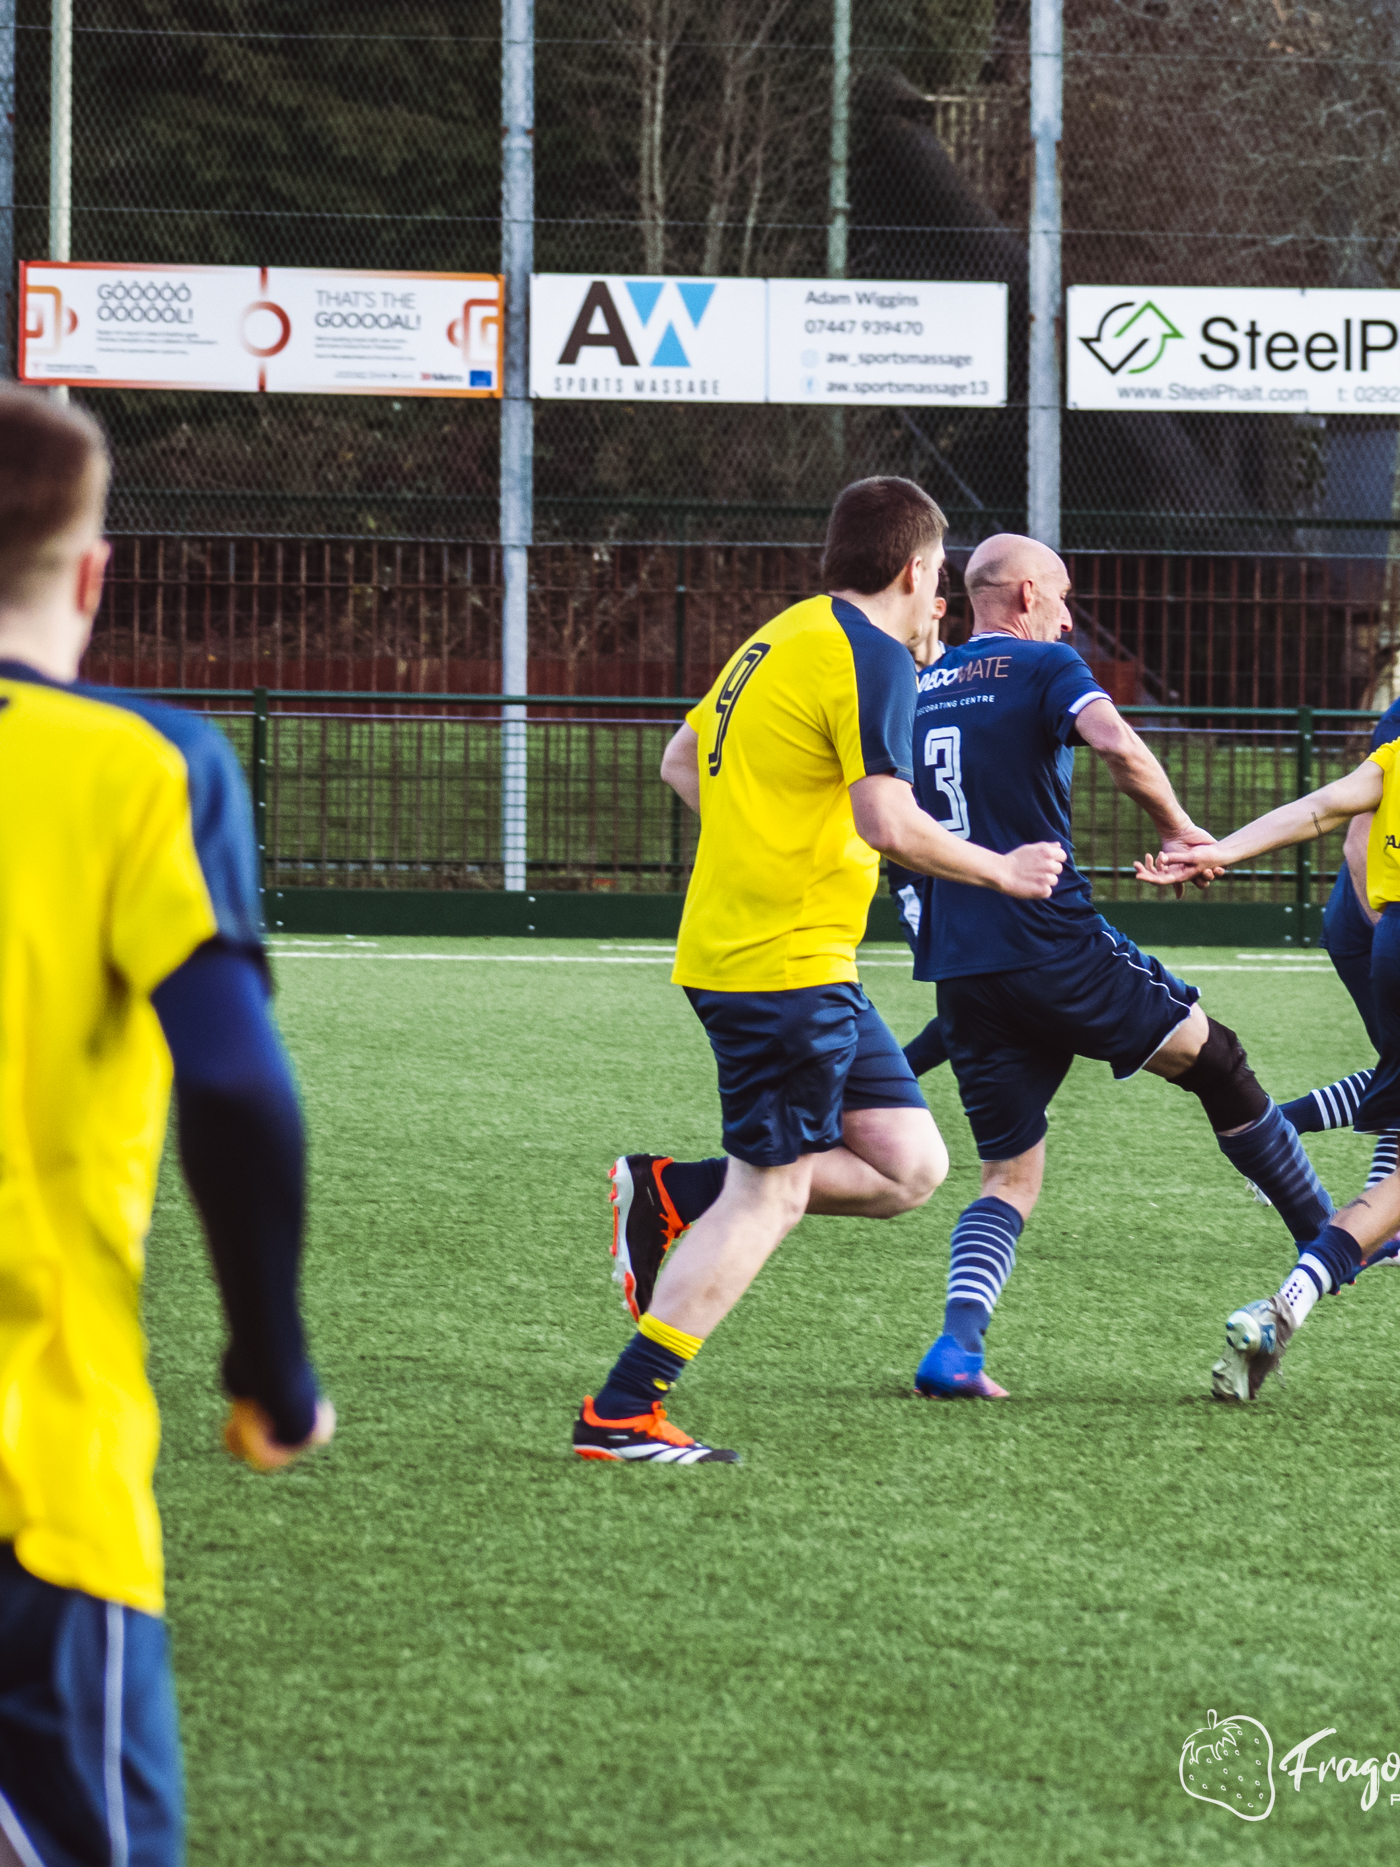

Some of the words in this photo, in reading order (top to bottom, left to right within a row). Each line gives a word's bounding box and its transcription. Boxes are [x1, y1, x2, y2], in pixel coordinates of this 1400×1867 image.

[315, 289, 377, 309] THAT'S
[381, 291, 417, 310] THE
[805, 291, 851, 304] Adam
[856, 292, 919, 309] Wiggins
[315, 311, 422, 331] GOOOOAL!
[557, 281, 717, 367] AW
[805, 319, 856, 334] 07447
[862, 321, 924, 336] 939470
[827, 353, 972, 368] aw_sportsmassage
[555, 377, 623, 393] SPORTS
[634, 379, 720, 395] MASSAGE
[1117, 383, 1309, 402] www.SteelPhalt.com
[708, 642, 771, 777] 9
[960, 694, 995, 706] CENTRE
[924, 725, 971, 841] 3
